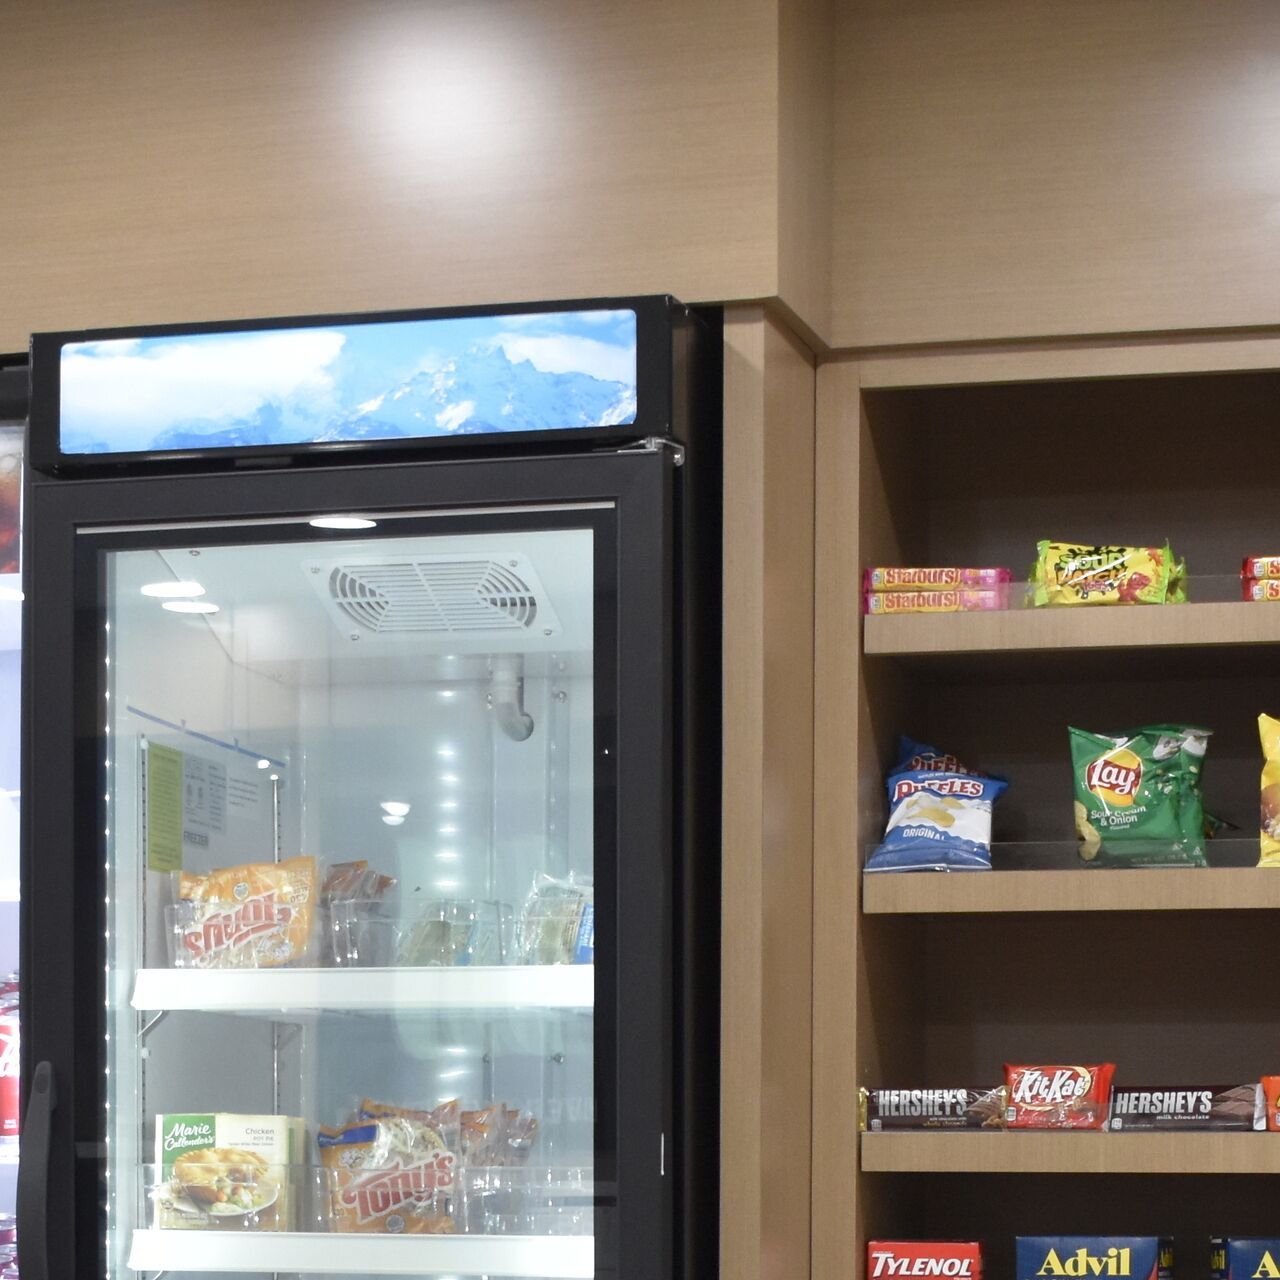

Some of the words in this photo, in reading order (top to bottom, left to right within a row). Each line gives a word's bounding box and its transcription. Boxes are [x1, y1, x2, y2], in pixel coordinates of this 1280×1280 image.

[886, 569, 959, 585] Starburst
[886, 592, 959, 608] Starburst
[893, 778, 984, 802] RUFFLES
[1101, 817, 1108, 826] &
[1109, 815, 1138, 825] Onion
[879, 1089, 968, 1116] HERSHEY'S
[1116, 1091, 1212, 1114] HERSHEY'S
[167, 1122, 211, 1139] Marie
[244, 1127, 275, 1136] Chicken
[164, 1135, 215, 1152] Callender's
[340, 1151, 455, 1224] Tony's
[872, 1253, 972, 1277] TYLENOL
[1036, 1247, 1131, 1276] Advil
